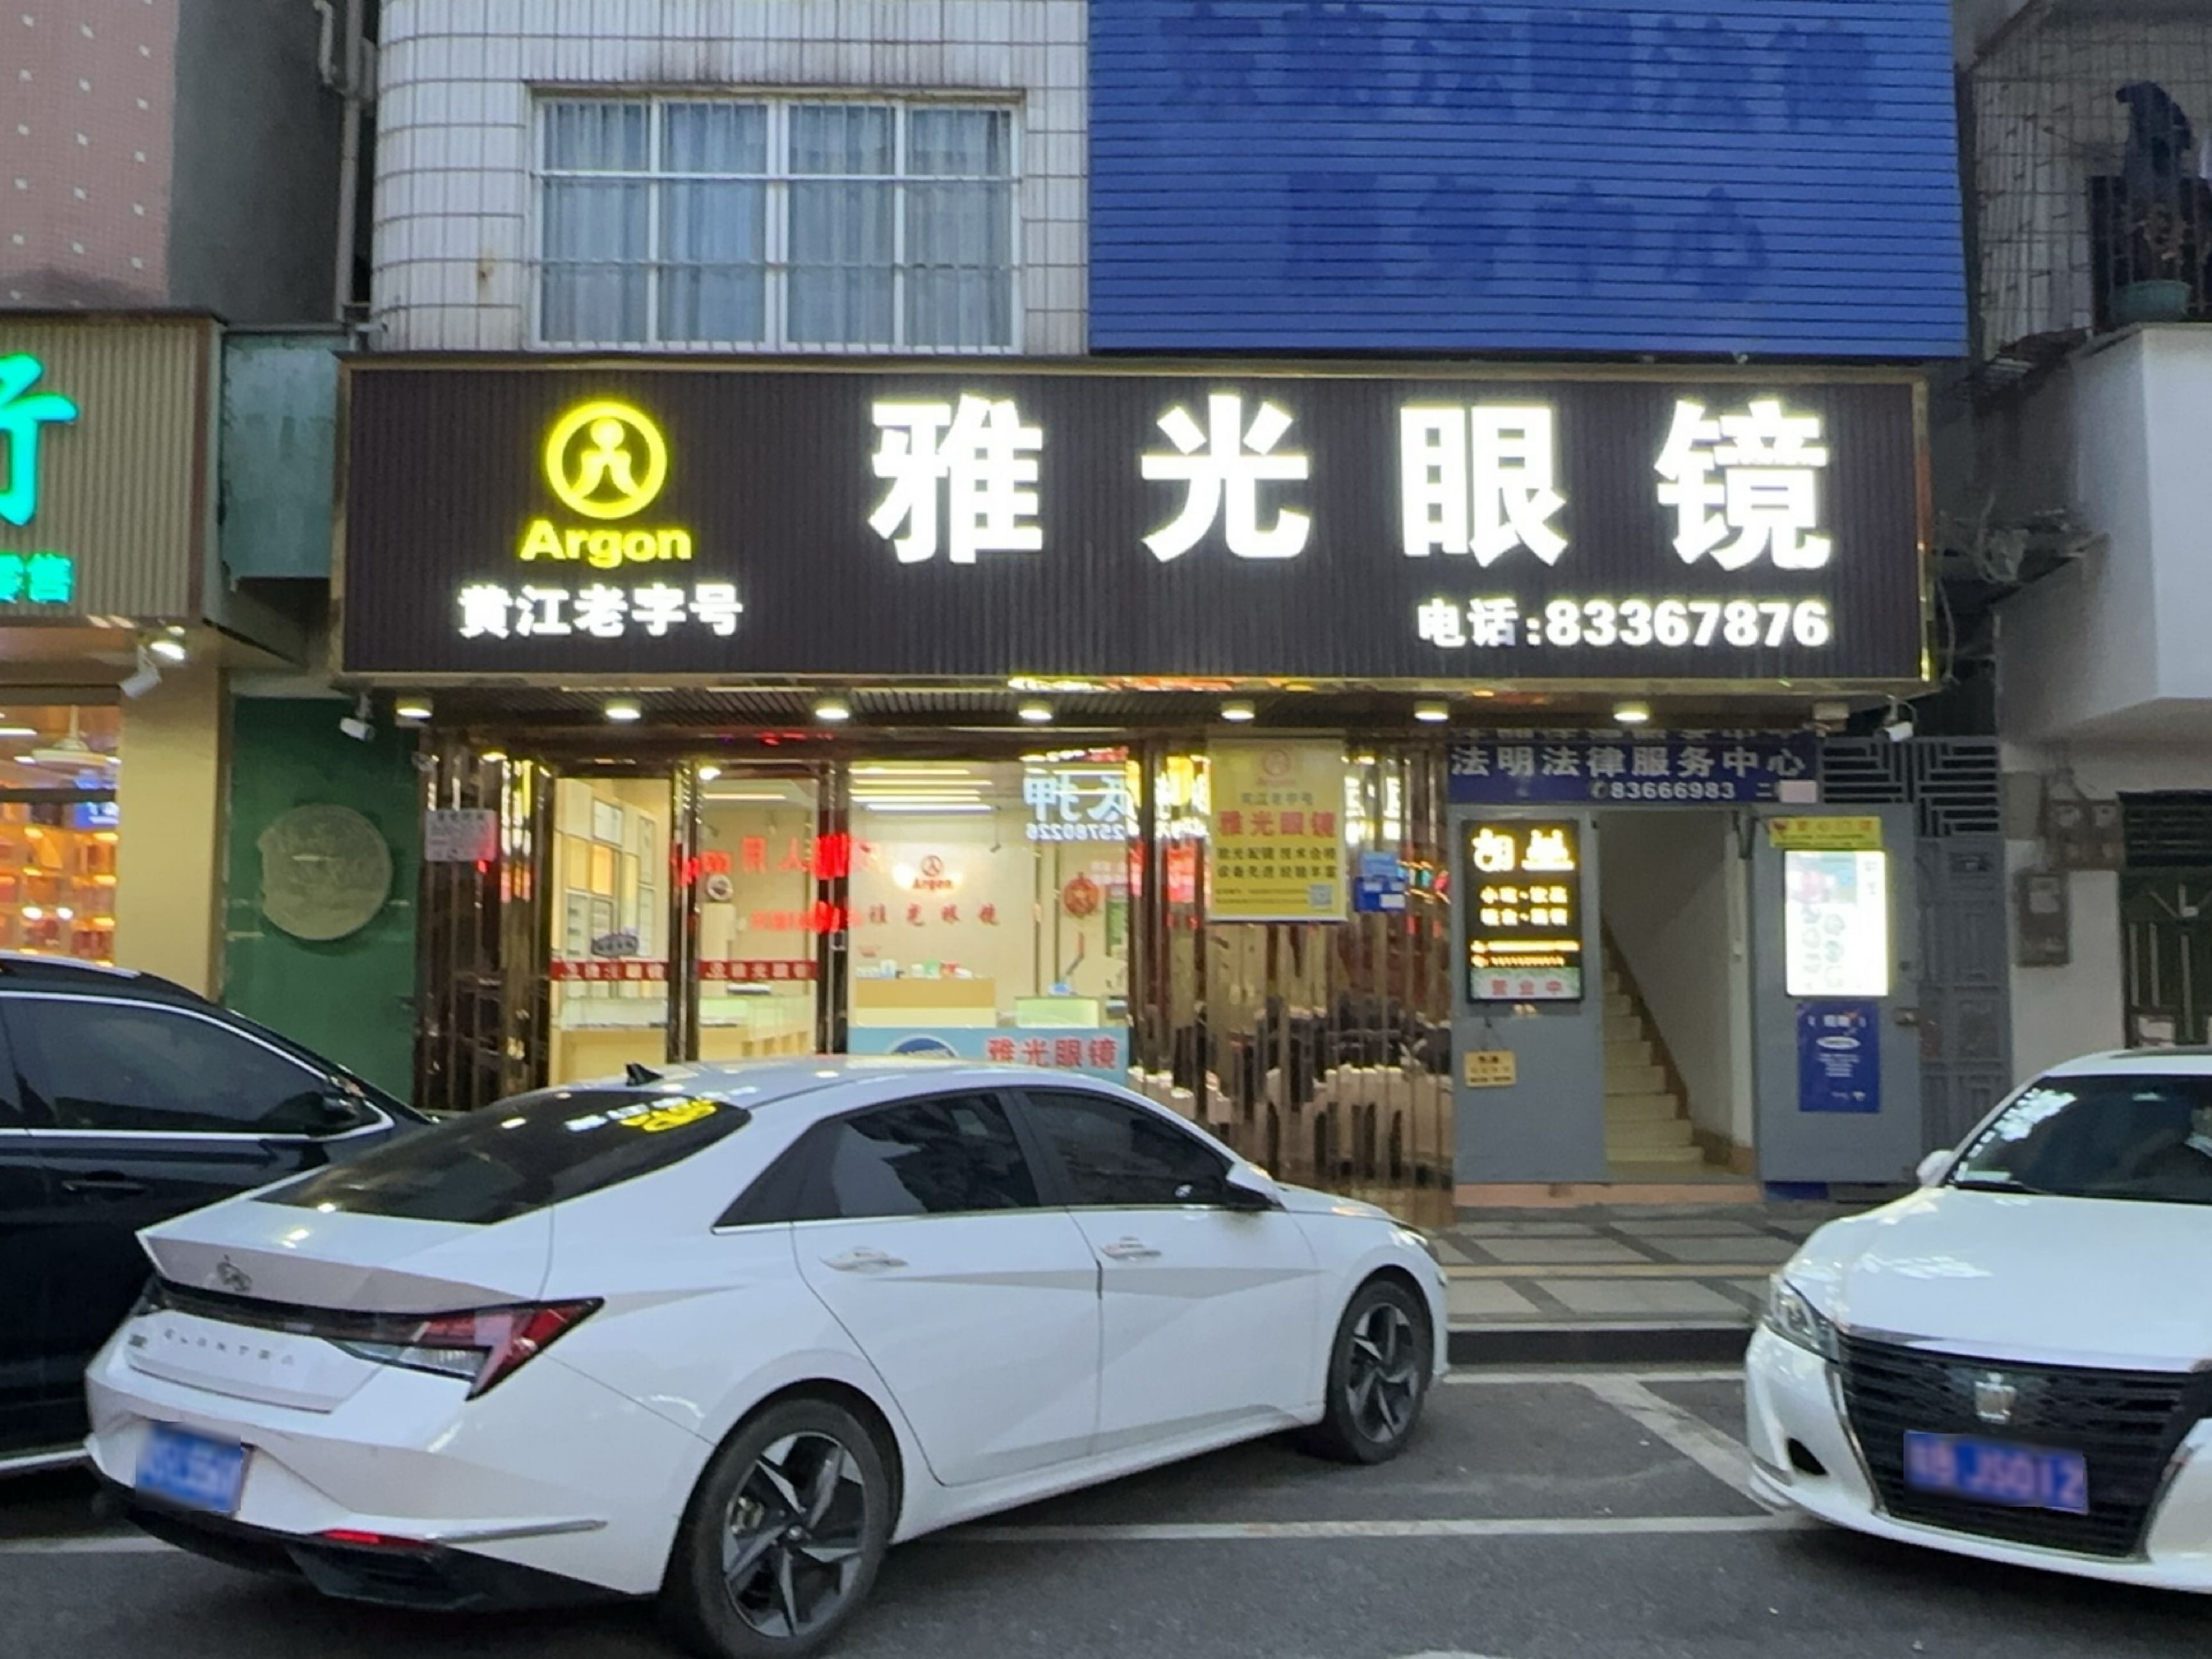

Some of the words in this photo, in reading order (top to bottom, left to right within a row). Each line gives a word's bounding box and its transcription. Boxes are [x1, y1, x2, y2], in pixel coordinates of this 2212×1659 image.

[868, 393, 1832, 572] 雅光眼镜
[520, 520, 692, 569] Argon
[457, 582, 744, 639] 黄江老字号
[1450, 745, 1806, 778] 法明法律服务中心
[1610, 780, 1736, 799] 83666983
[1219, 810, 1336, 838] 雅光眼镜
[987, 1036, 1119, 1070] 雅光眼镜
